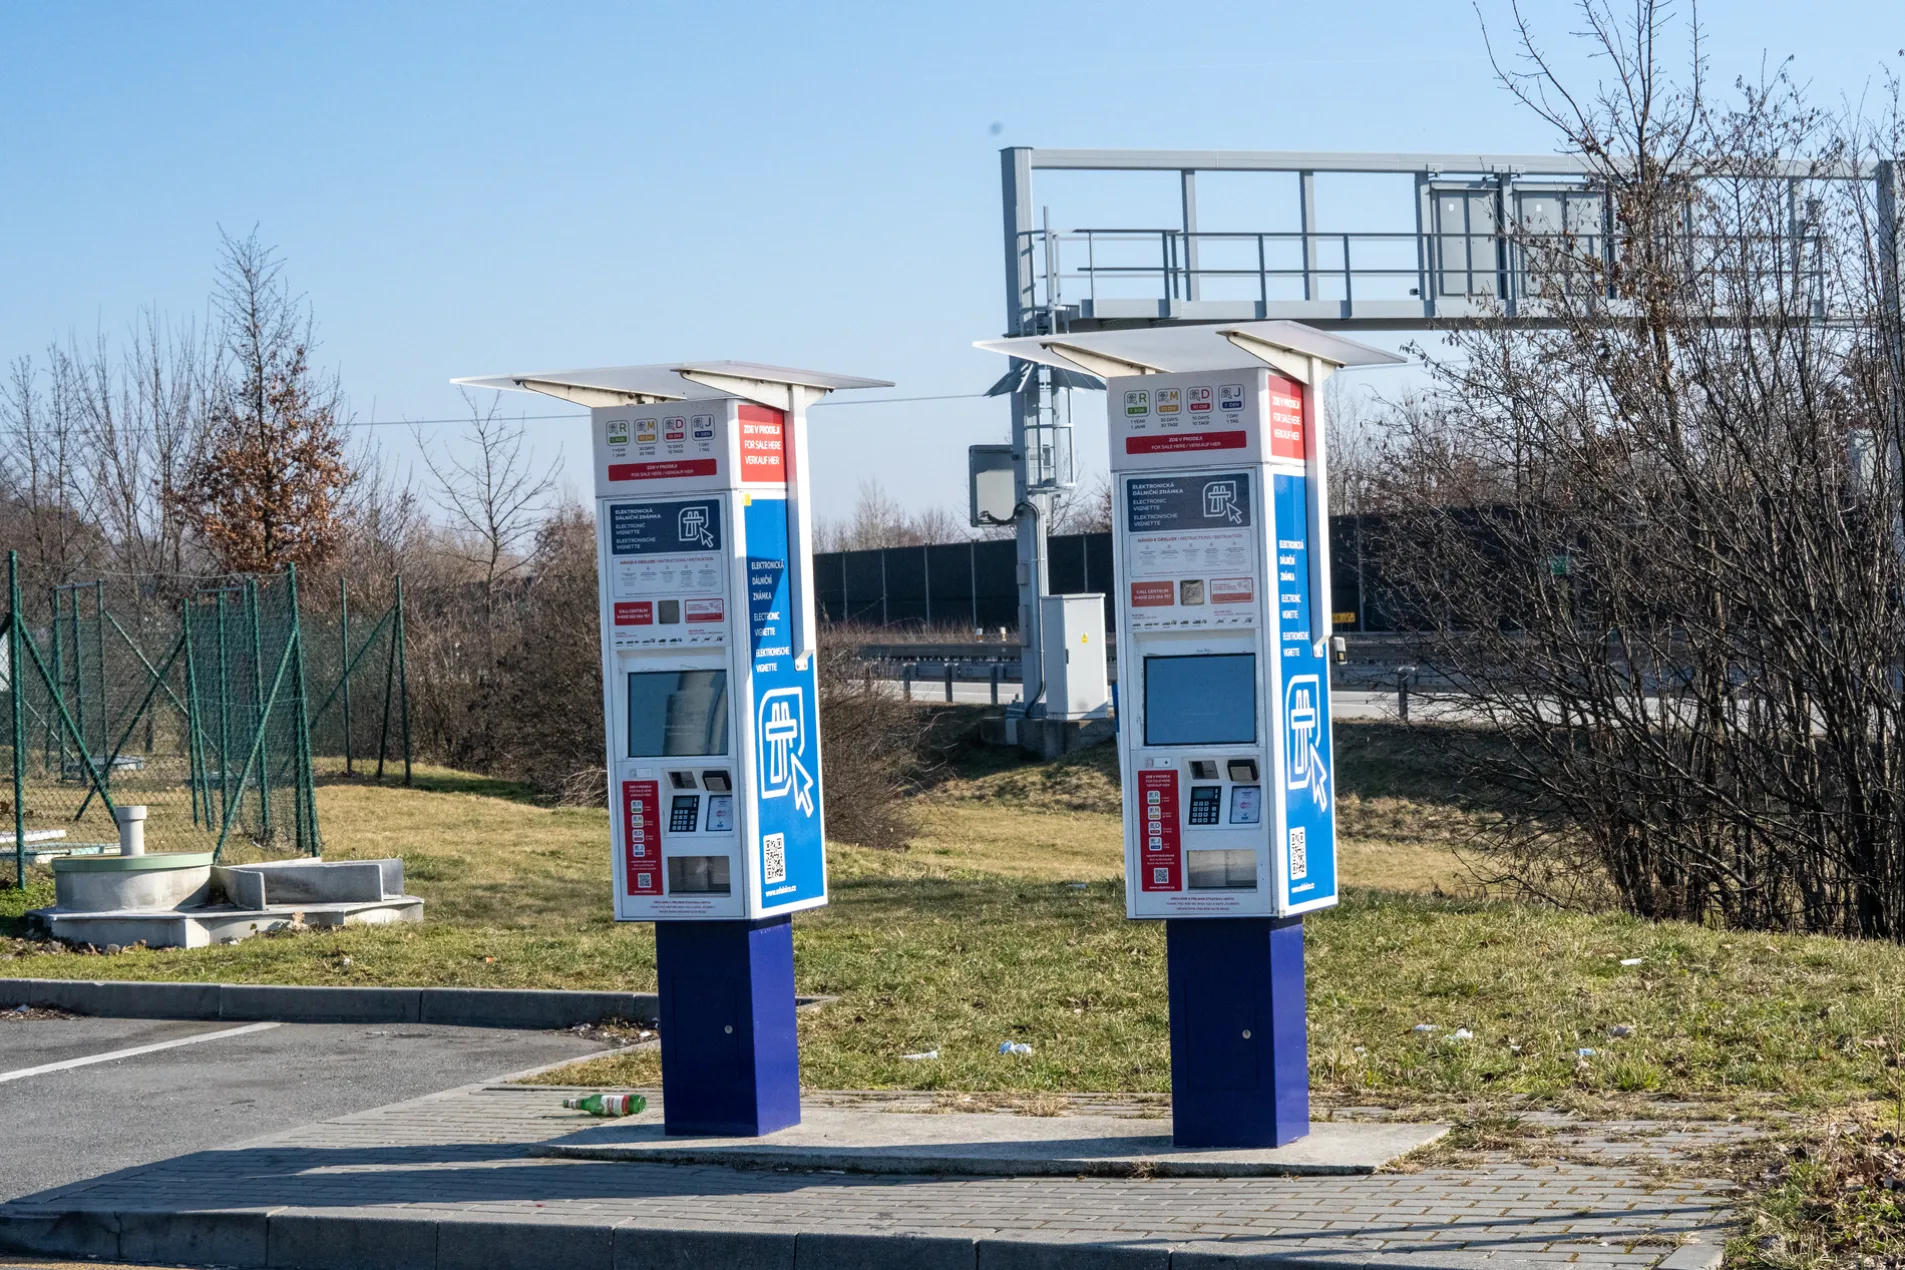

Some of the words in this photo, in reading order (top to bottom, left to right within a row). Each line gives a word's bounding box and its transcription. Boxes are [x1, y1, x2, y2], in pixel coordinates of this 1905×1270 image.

[1170, 391, 1178, 400] M
[1202, 389, 1210, 399] D
[1234, 387, 1240, 397] J
[1139, 393, 1147, 402] R
[648, 421, 655, 430] M
[676, 419, 683, 428] D
[705, 417, 712, 427] J
[620, 423, 627, 432] R
[744, 424, 754, 433] ZDE
[744, 440, 754, 449] FOR
[756, 440, 768, 449] SALE
[768, 441, 781, 450] HERE
[745, 456, 768, 464] VERKAUF
[768, 456, 780, 464] HIER
[752, 558, 784, 570] ELEKTRONICKÁ
[752, 574, 772, 585] DÁLNIČNÍ
[753, 590, 772, 600] ZNÁMKA
[754, 611, 780, 621] ELECTRONIC
[754, 627, 775, 636] VIGNETTE
[756, 646, 789, 657] ELEKTRONISCHE
[756, 663, 777, 672] VIGNETTE
